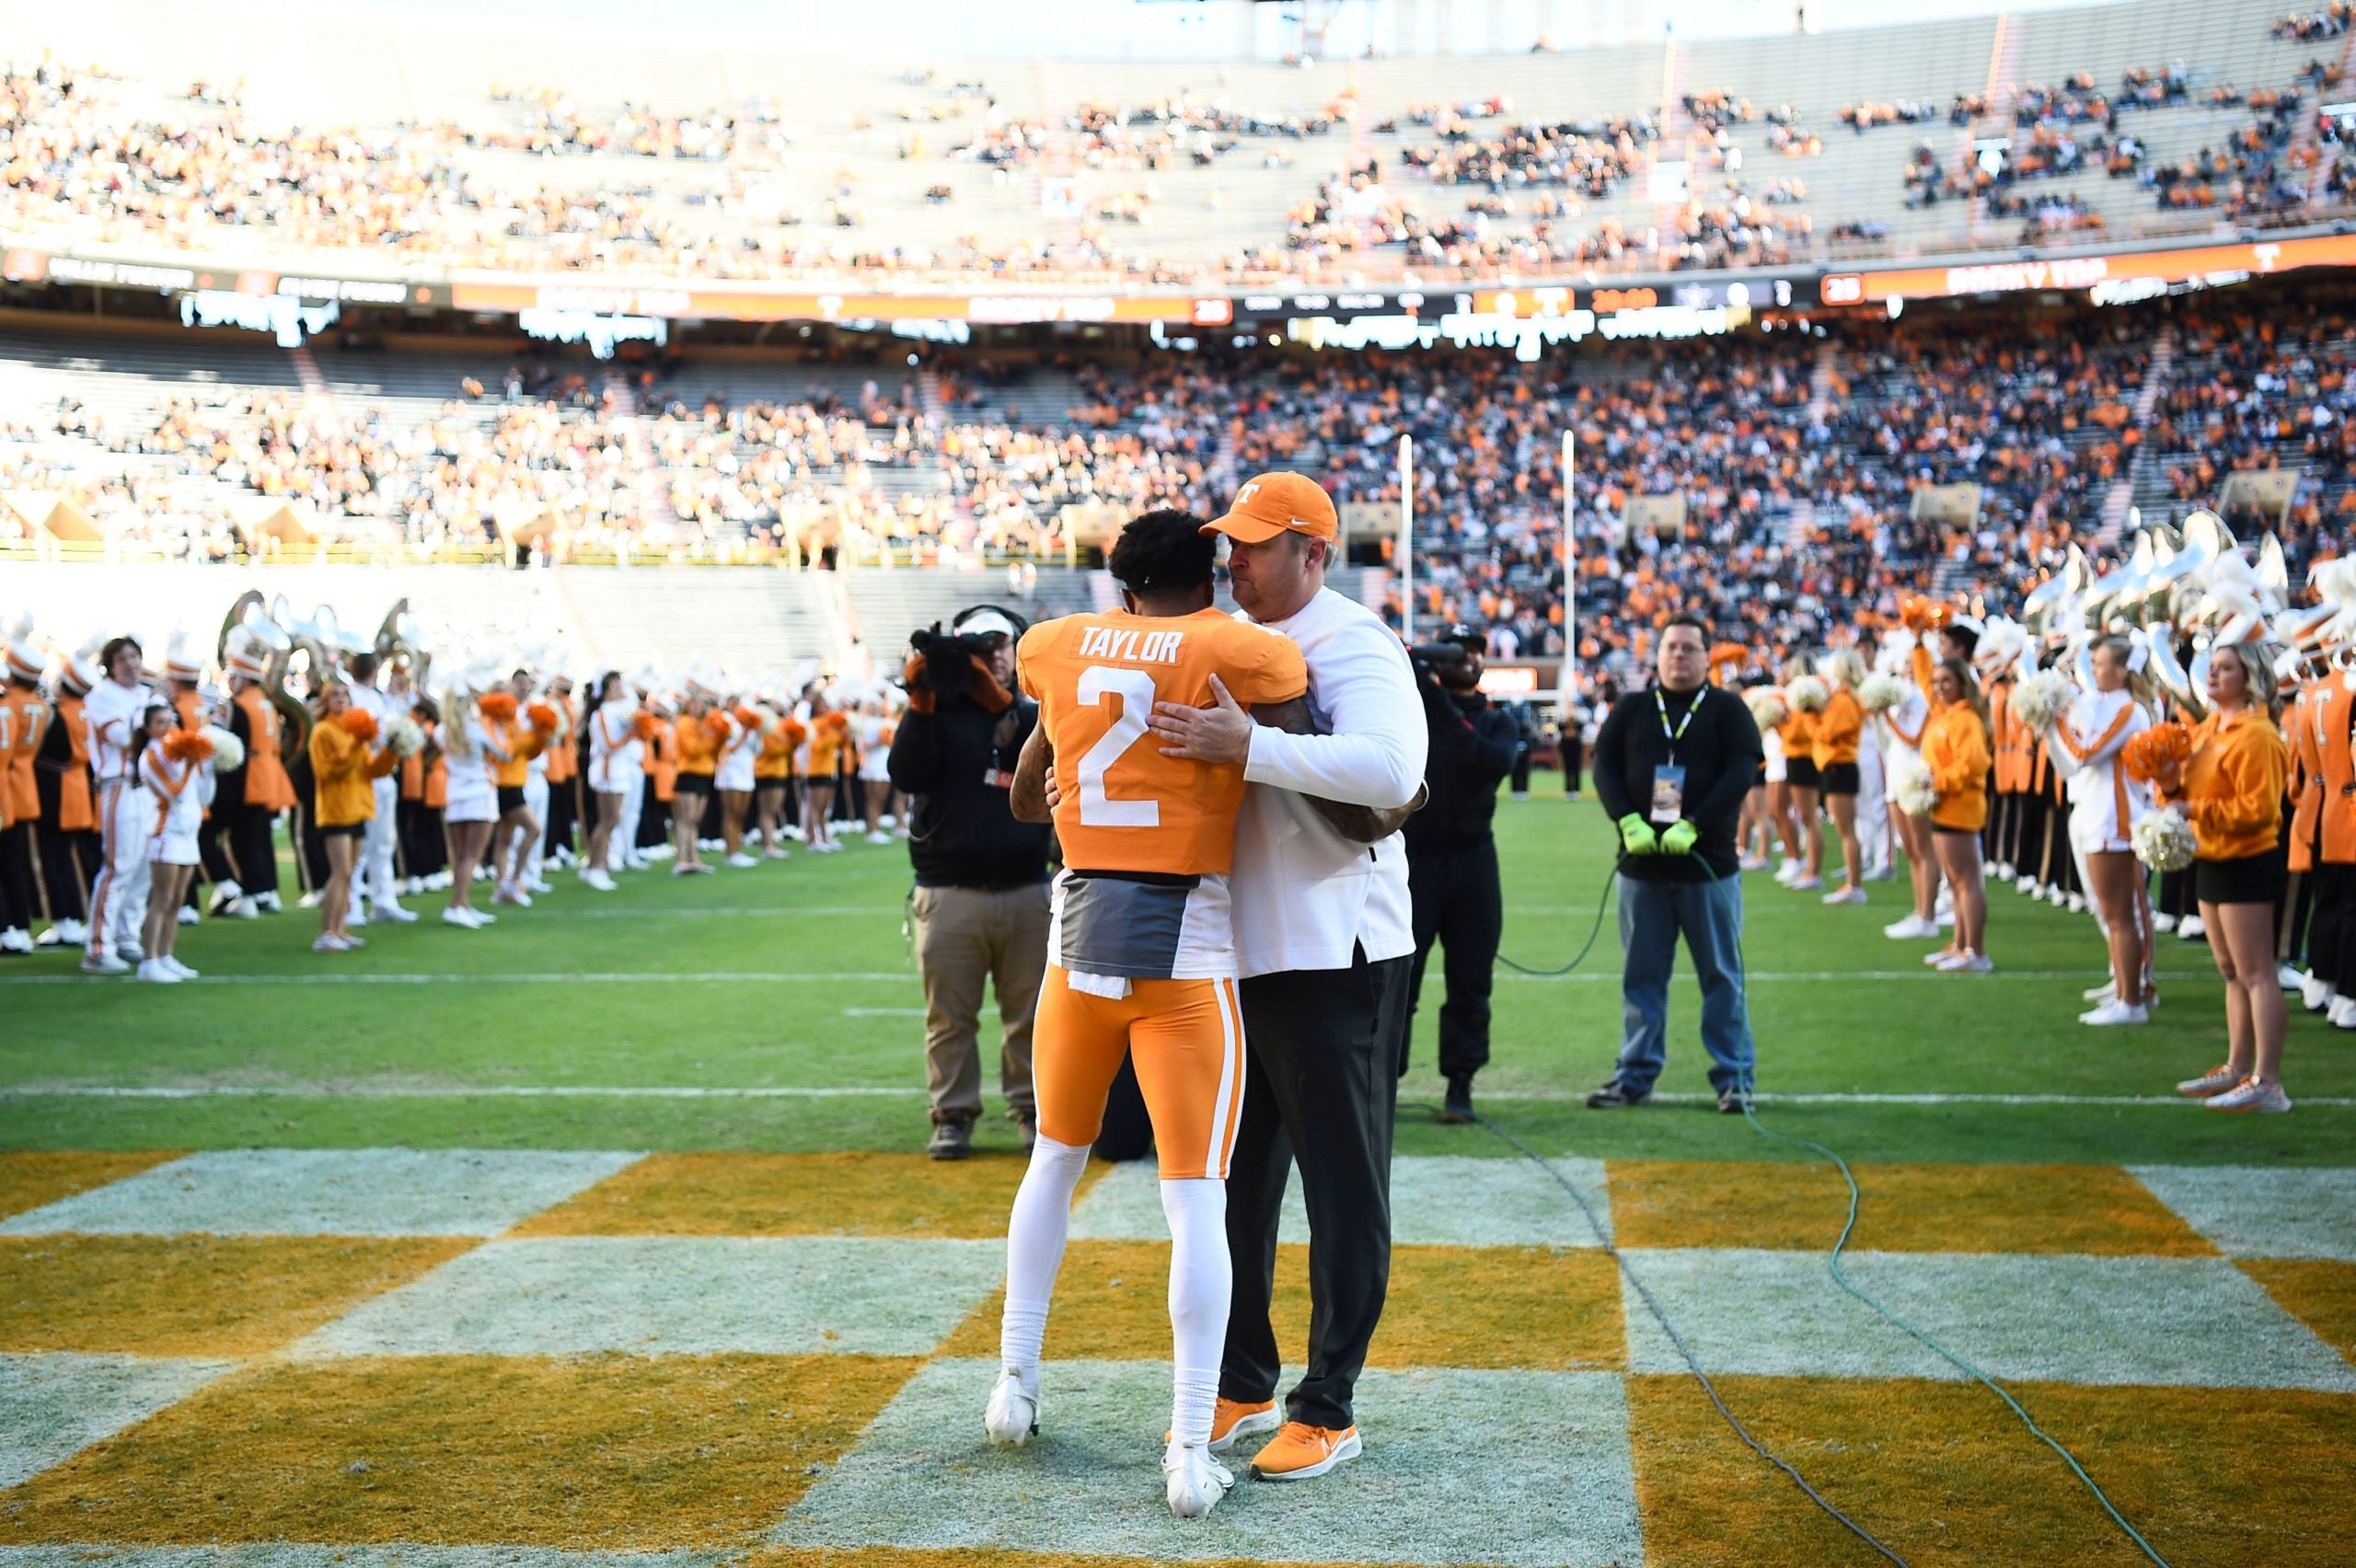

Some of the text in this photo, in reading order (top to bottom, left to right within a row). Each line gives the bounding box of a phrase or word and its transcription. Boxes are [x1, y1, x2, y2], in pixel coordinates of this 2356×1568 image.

[1238, 483, 1261, 503] T
[1079, 626, 1184, 663] TAYLOR
[22, 702, 45, 745] T
[2312, 686, 2335, 747] T
[1077, 665, 1161, 827] 2
